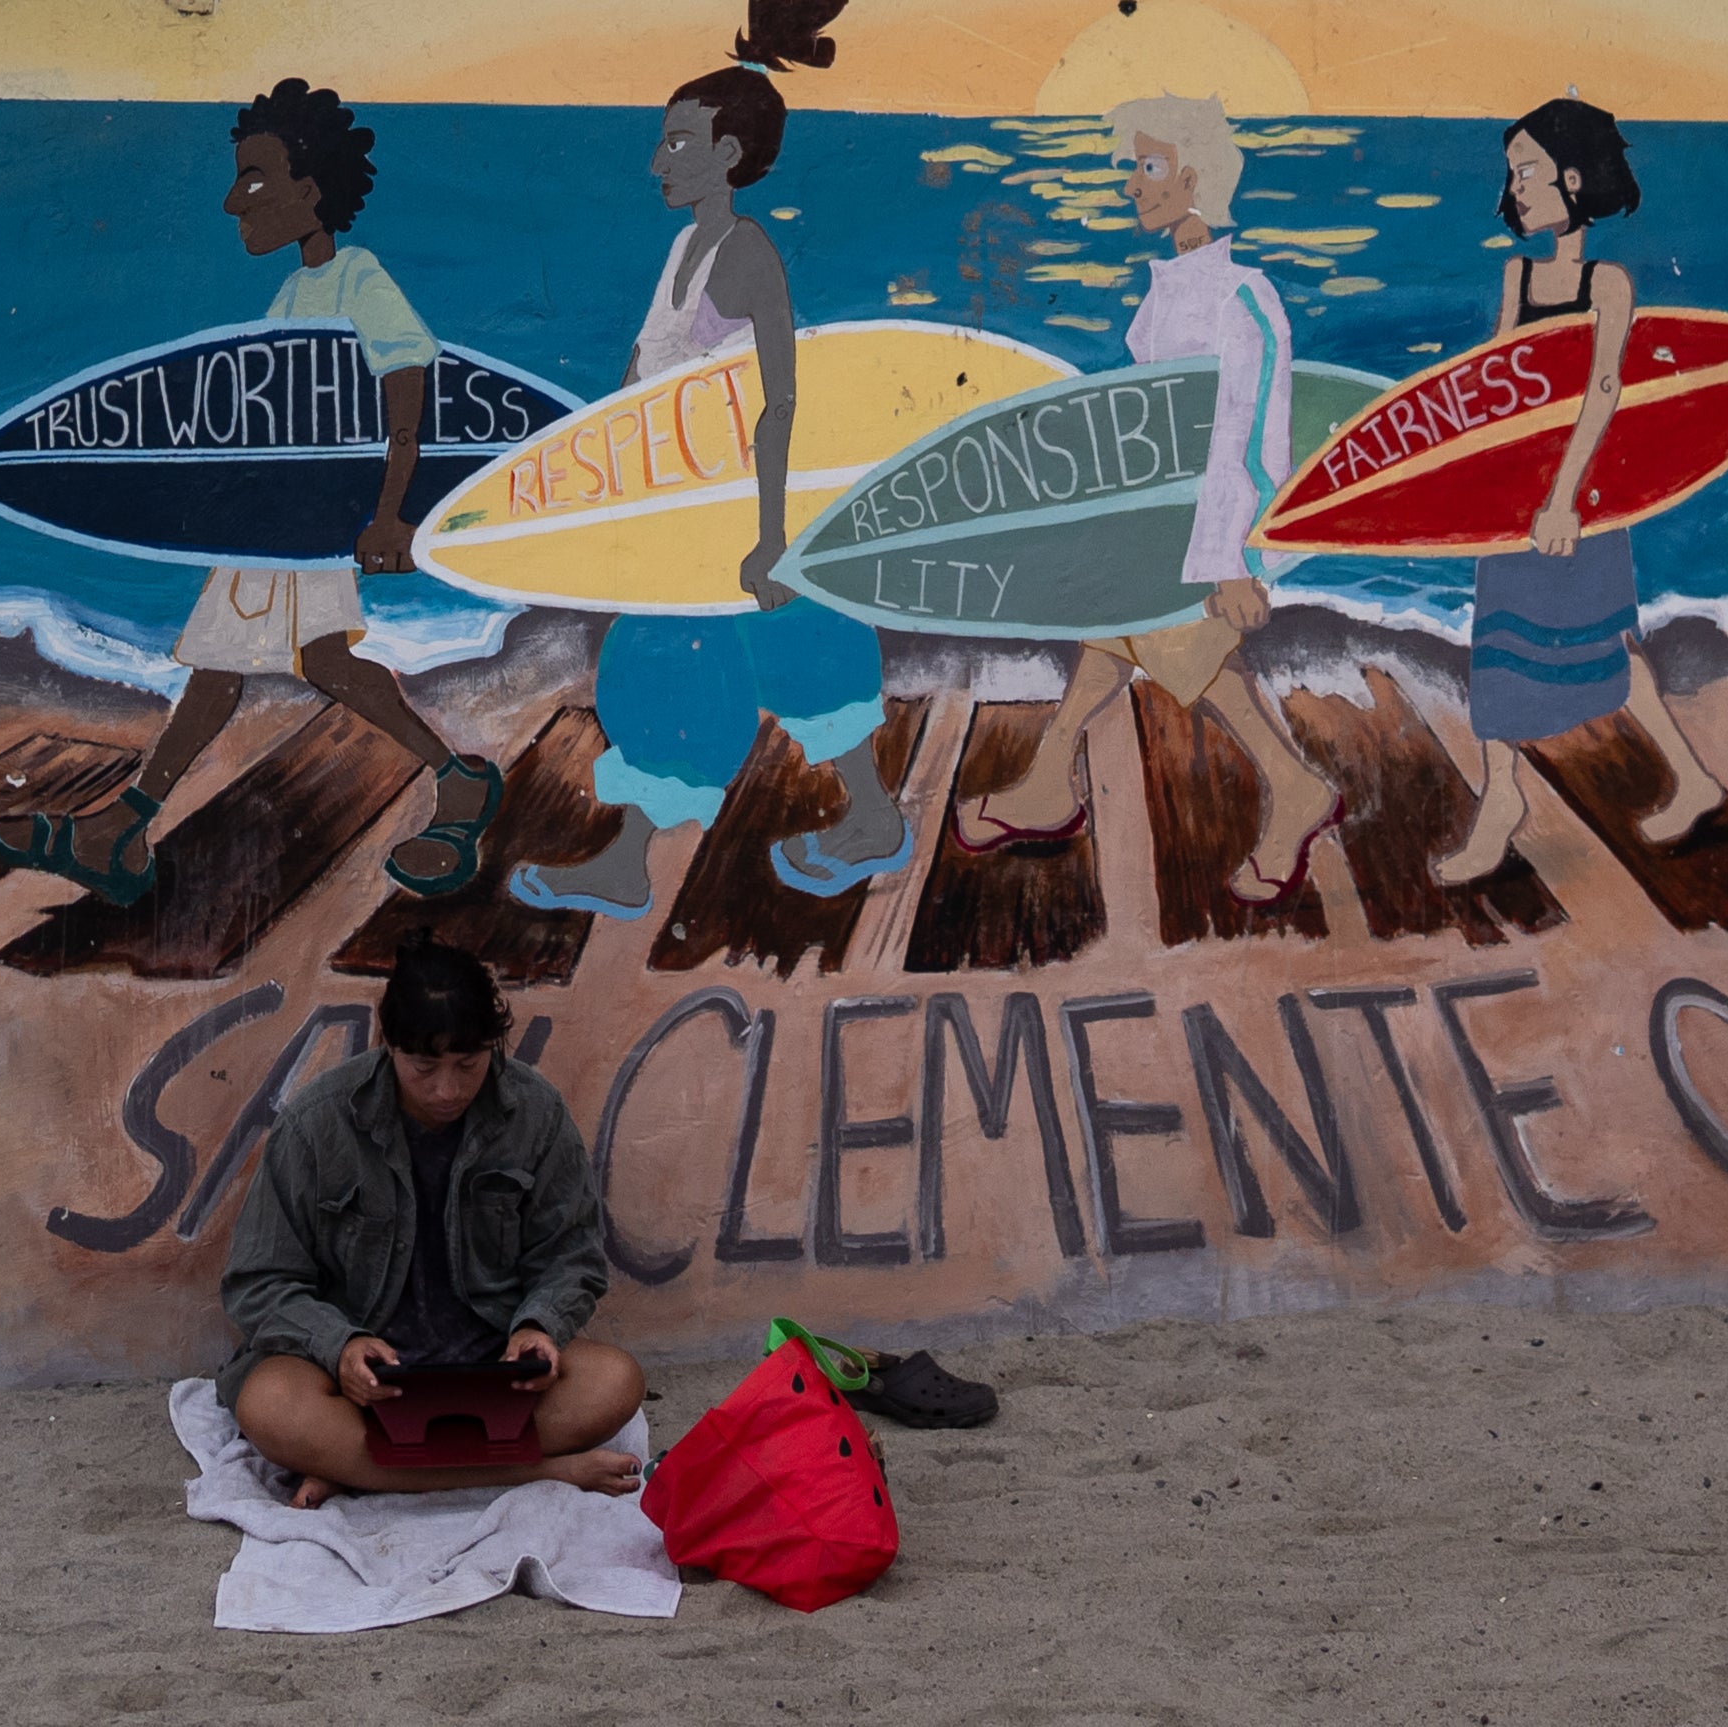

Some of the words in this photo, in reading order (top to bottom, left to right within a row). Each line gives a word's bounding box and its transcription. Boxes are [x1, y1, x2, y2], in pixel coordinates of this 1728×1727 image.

[508, 360, 752, 518] RESPECT
[851, 377, 1214, 542] RESPONSIBI-
[1322, 344, 1552, 490] FAIRNESS
[874, 559, 1015, 619] LITY
[590, 966, 1657, 1286] CLEMENTE
